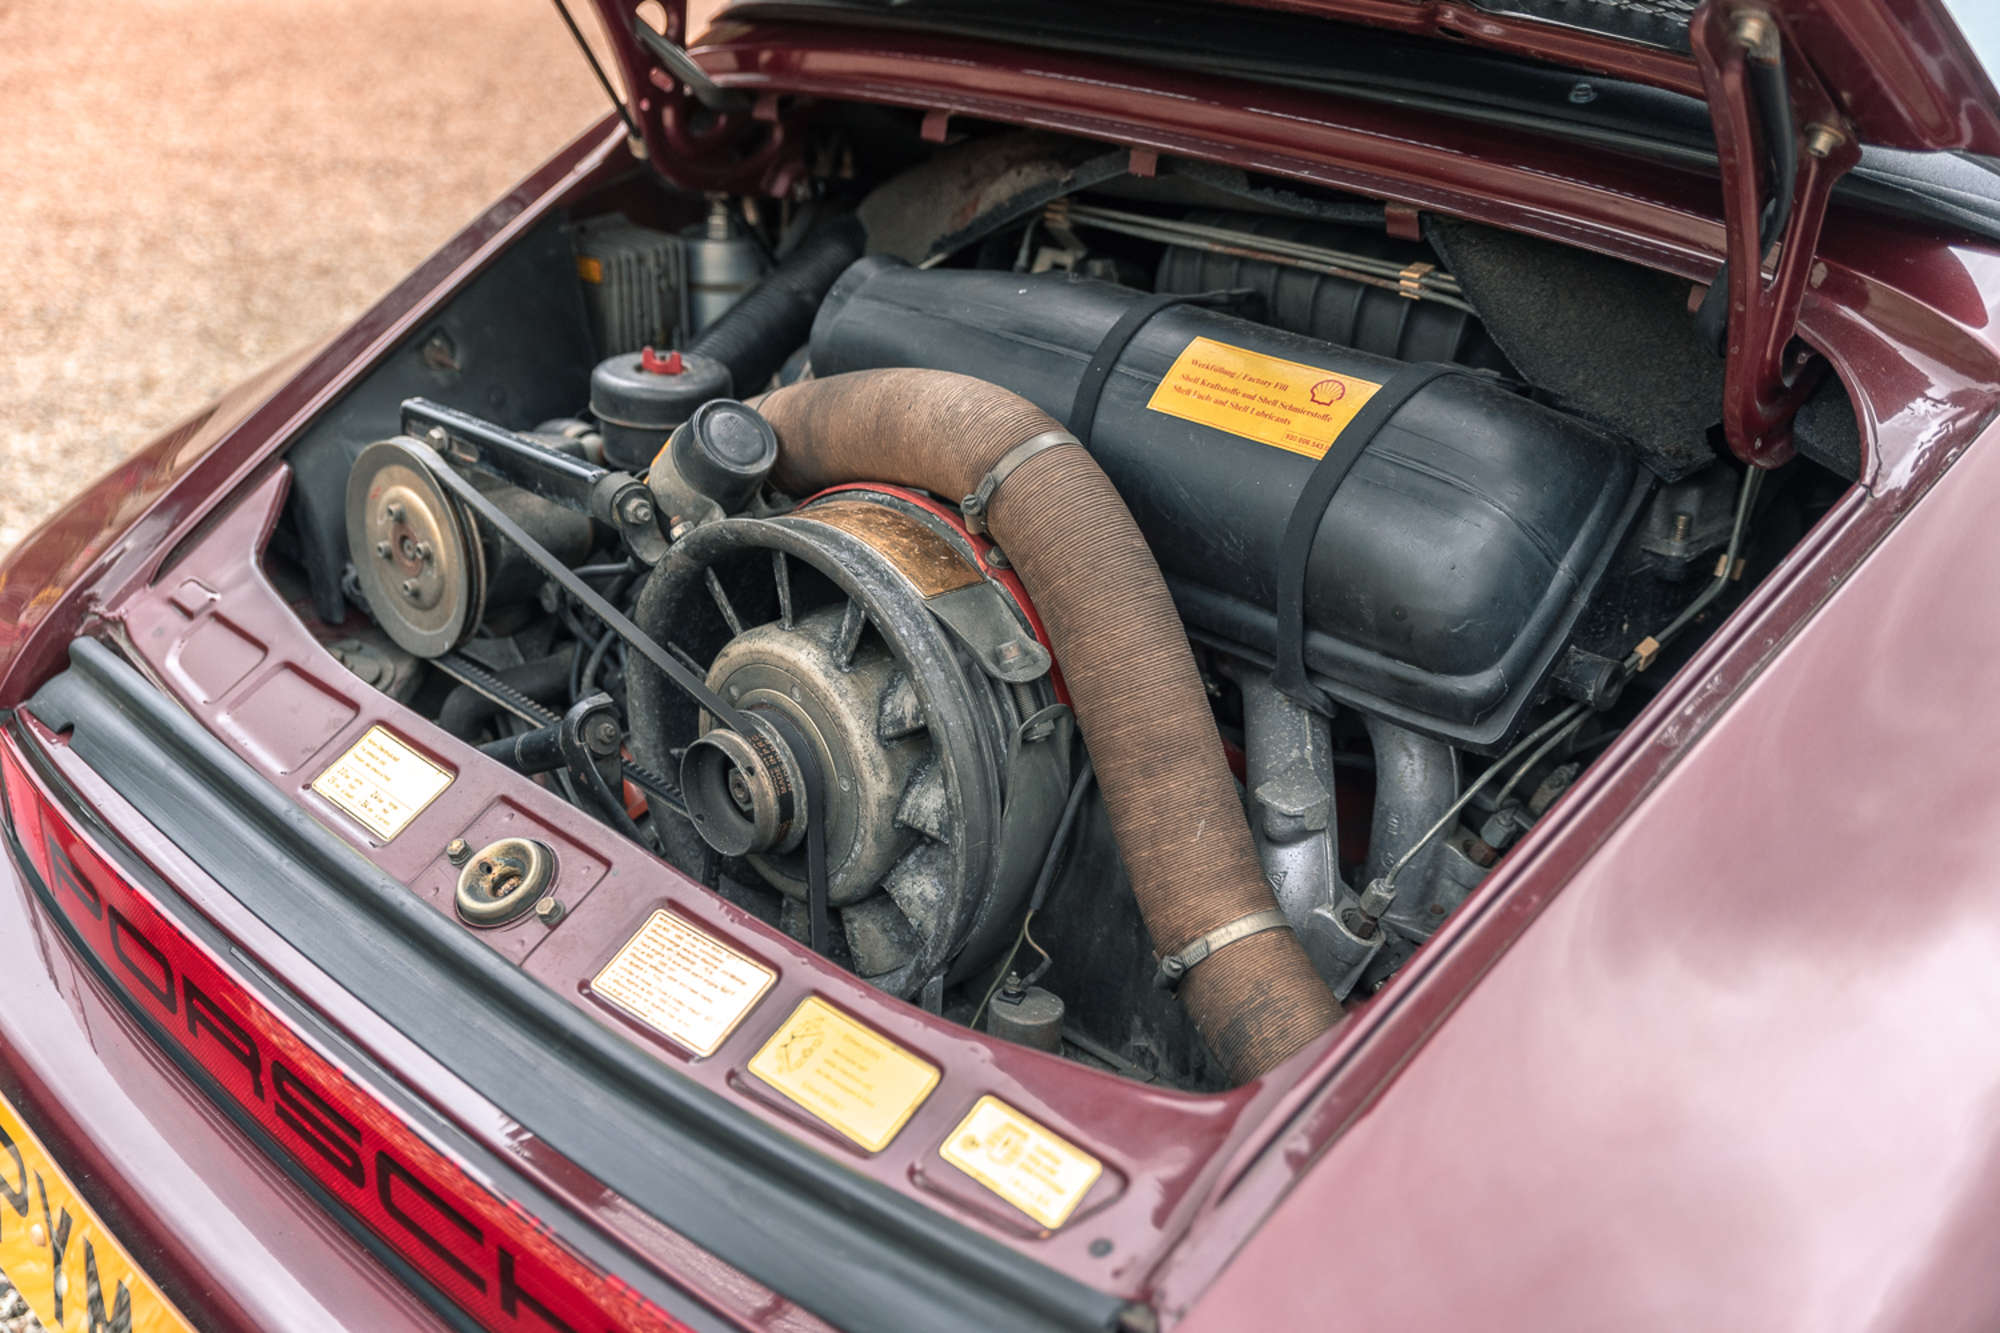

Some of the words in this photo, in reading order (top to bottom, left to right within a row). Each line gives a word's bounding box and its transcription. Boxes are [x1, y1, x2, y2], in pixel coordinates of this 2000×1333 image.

[1181, 373, 1200, 385] Shell
[1200, 379, 1241, 396] Kraftstoffe
[1257, 396, 1279, 407] Shell
[1279, 402, 1333, 422] Schmierstoffe
[1242, 373, 1272, 388] Factory
[1274, 382, 1289, 391] Fill
[1173, 383, 1193, 396] Shell
[1213, 399, 1229, 407] and
[1230, 402, 1250, 413] Shell
[1250, 408, 1292, 425] Lubricants
